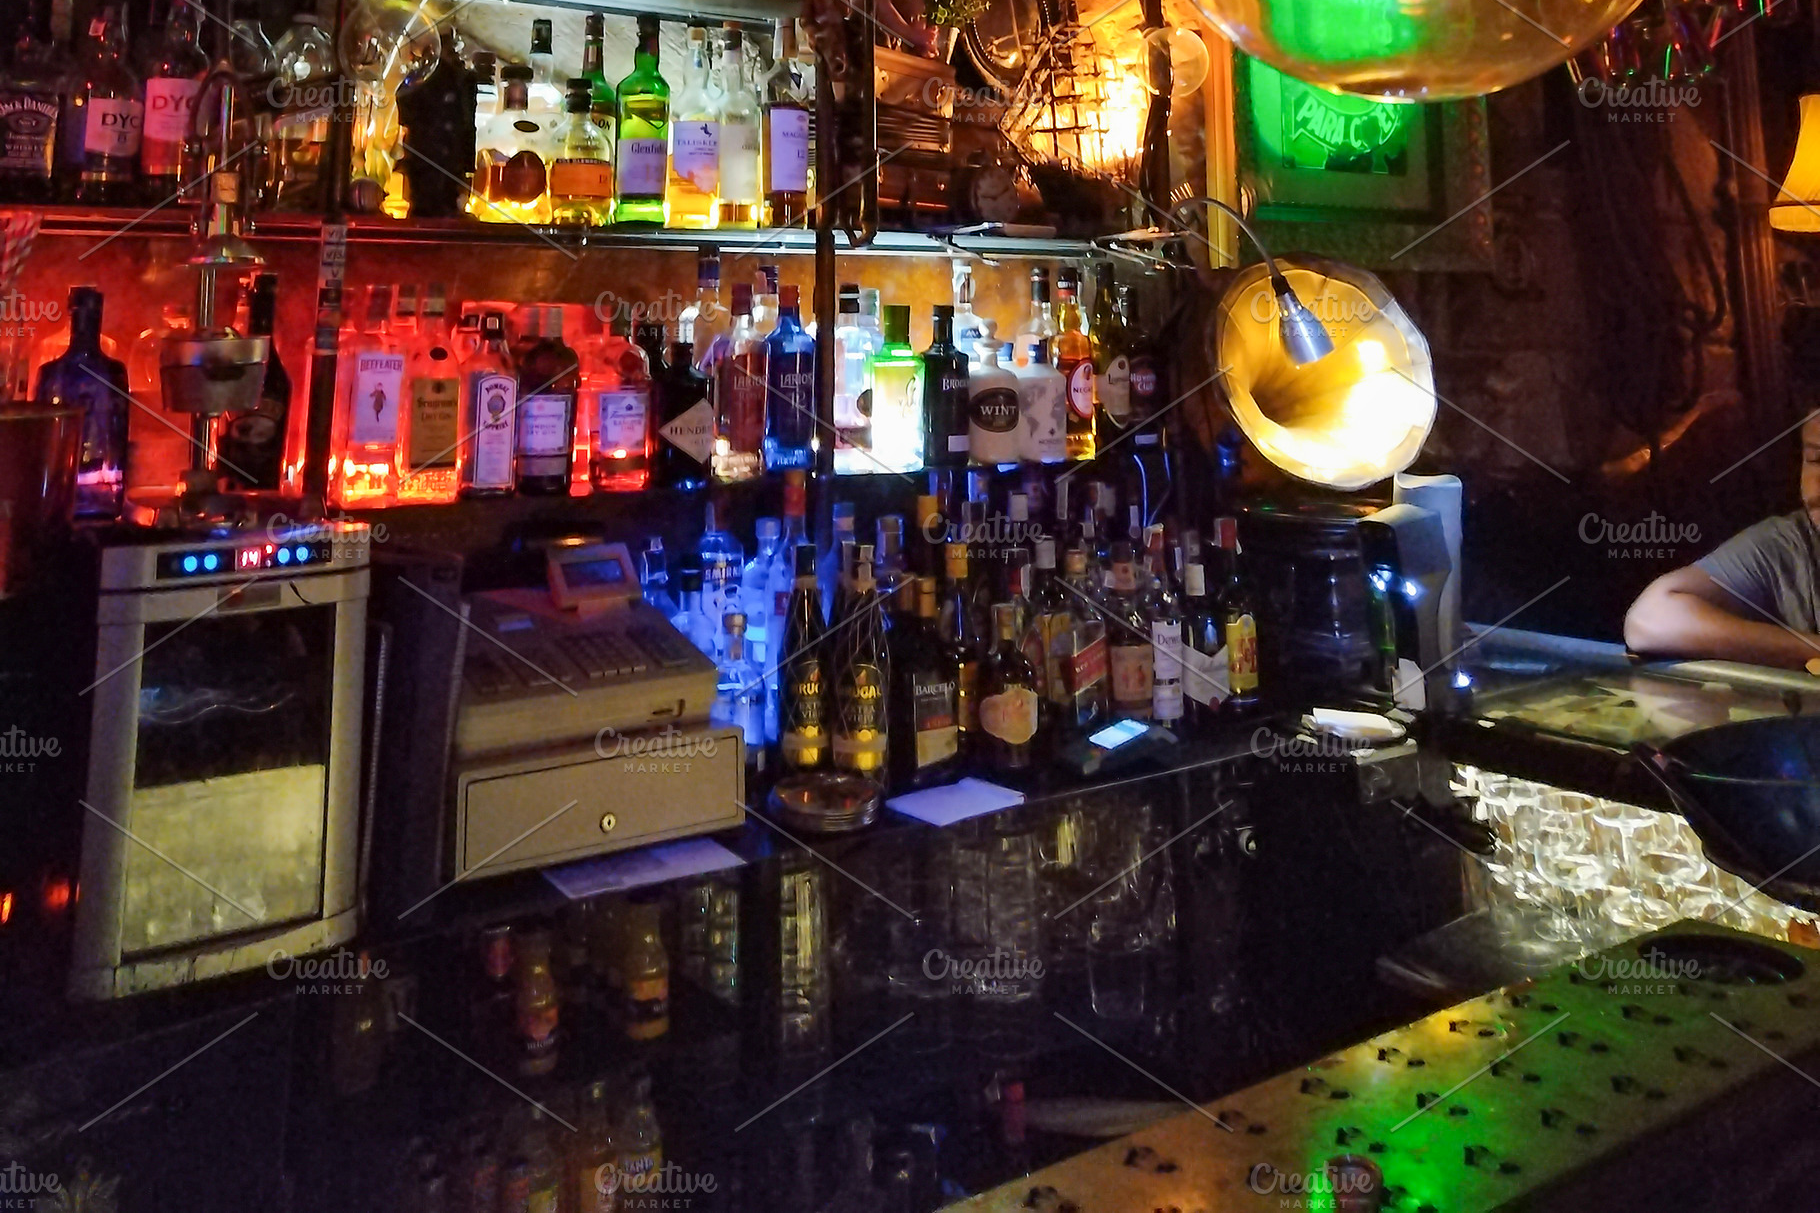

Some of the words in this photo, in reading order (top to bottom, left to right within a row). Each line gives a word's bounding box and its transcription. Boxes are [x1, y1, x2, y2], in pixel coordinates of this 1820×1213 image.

[1296, 95, 1346, 145] PARA
[359, 358, 403, 372] BEEFEATER
[780, 373, 813, 388] LARIOS
